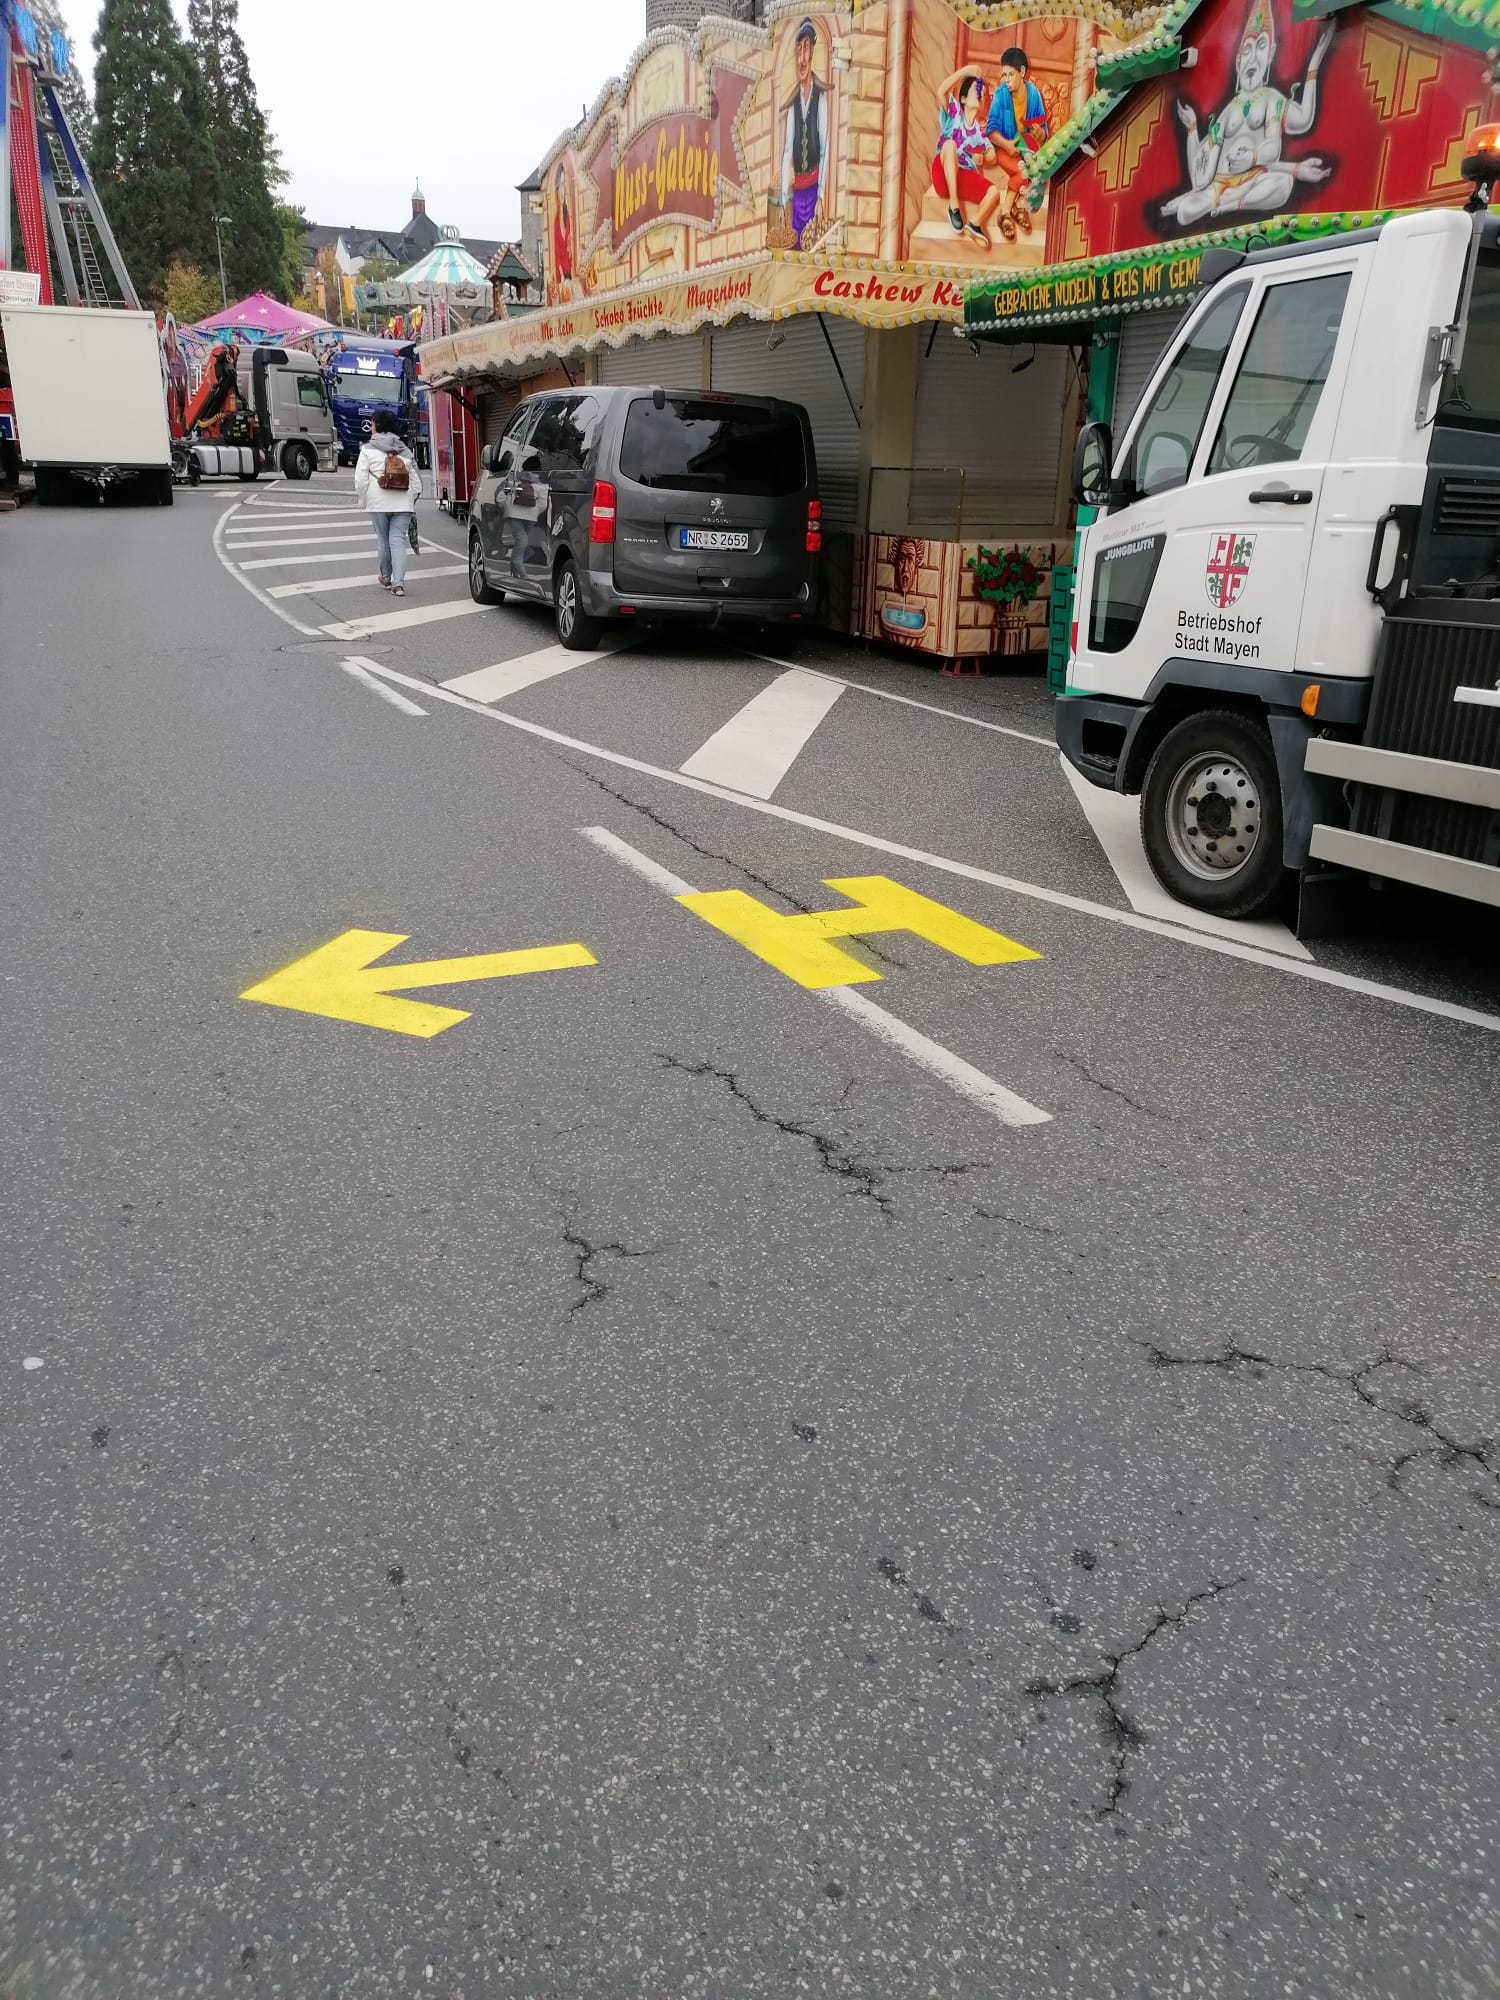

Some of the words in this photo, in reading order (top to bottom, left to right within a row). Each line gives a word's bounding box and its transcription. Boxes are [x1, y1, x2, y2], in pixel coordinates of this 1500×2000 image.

[615, 123, 718, 232] Nuss-Galerie
[687, 273, 752, 310] Magenbrot
[814, 271, 922, 303] Cashew
[994, 284, 1052, 316] GEBRATENE
[1055, 276, 1096, 307] NUDELN
[1102, 276, 1110, 299] &
[1113, 268, 1139, 298] REIS
[1143, 264, 1164, 293] MIT
[594, 307, 624, 328] Schoko
[626, 296, 663, 322] Früchte
[688, 529, 702, 544] NR
[710, 532, 718, 545] S
[720, 534, 748, 547] 2659
[1104, 538, 1155, 561] JUNGBLUTH
[1178, 610, 1262, 634] Betriebshof
[1174, 632, 1209, 652] Stadt
[1213, 636, 1260, 660] Mayen
